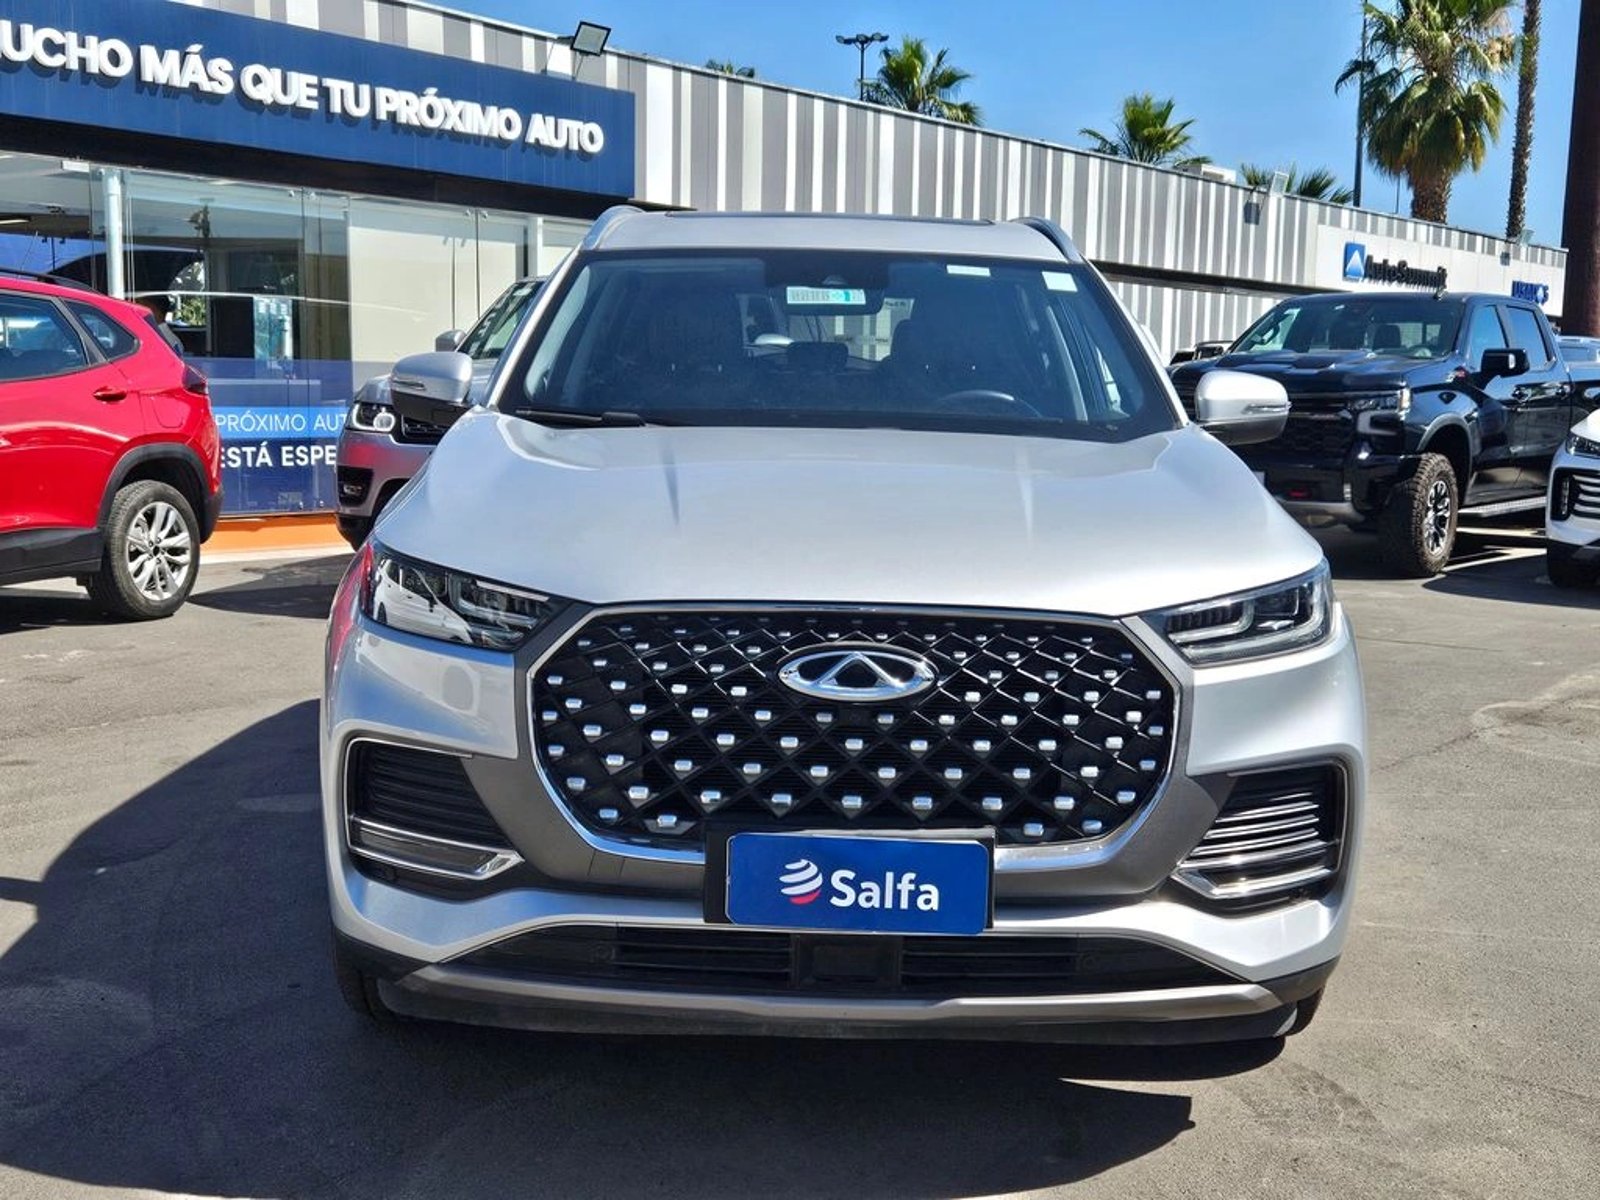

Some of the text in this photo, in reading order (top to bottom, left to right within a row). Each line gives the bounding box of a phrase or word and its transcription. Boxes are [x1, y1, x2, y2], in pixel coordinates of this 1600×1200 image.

[0, 19, 605, 154] UCHO MÁS QUE TU PRÓXIMO AUTO
[215, 410, 306, 432] PRÓXIMO
[281, 445, 337, 467] ESPE
[830, 869, 940, 911] Salfa
